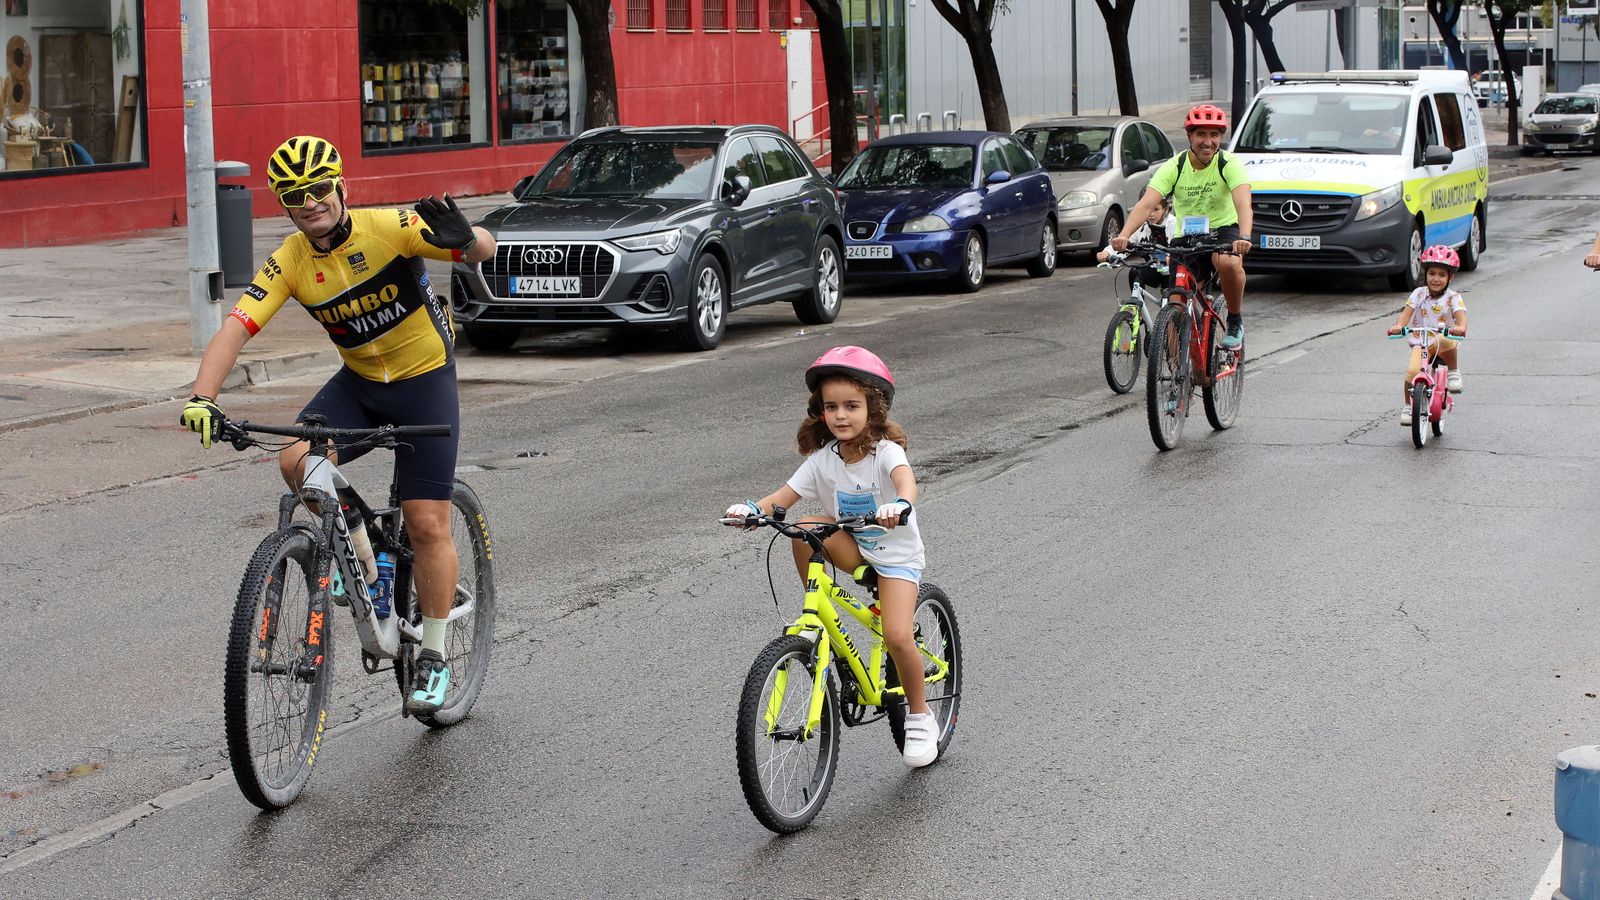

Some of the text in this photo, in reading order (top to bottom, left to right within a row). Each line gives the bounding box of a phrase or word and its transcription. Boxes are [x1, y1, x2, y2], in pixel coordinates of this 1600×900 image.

[1431, 185, 1463, 211] AMBULANCIAS
[848, 247, 889, 257] 240 FFC
[1267, 237, 1318, 248] 8826 JPC
[519, 279, 577, 292] 4714 LVK
[313, 283, 399, 324] JUMBO
[347, 301, 408, 334] VISMA
[476, 513, 493, 561] MAXXIS
[308, 609, 324, 646] FOX
[306, 708, 327, 767] MAXXIS
